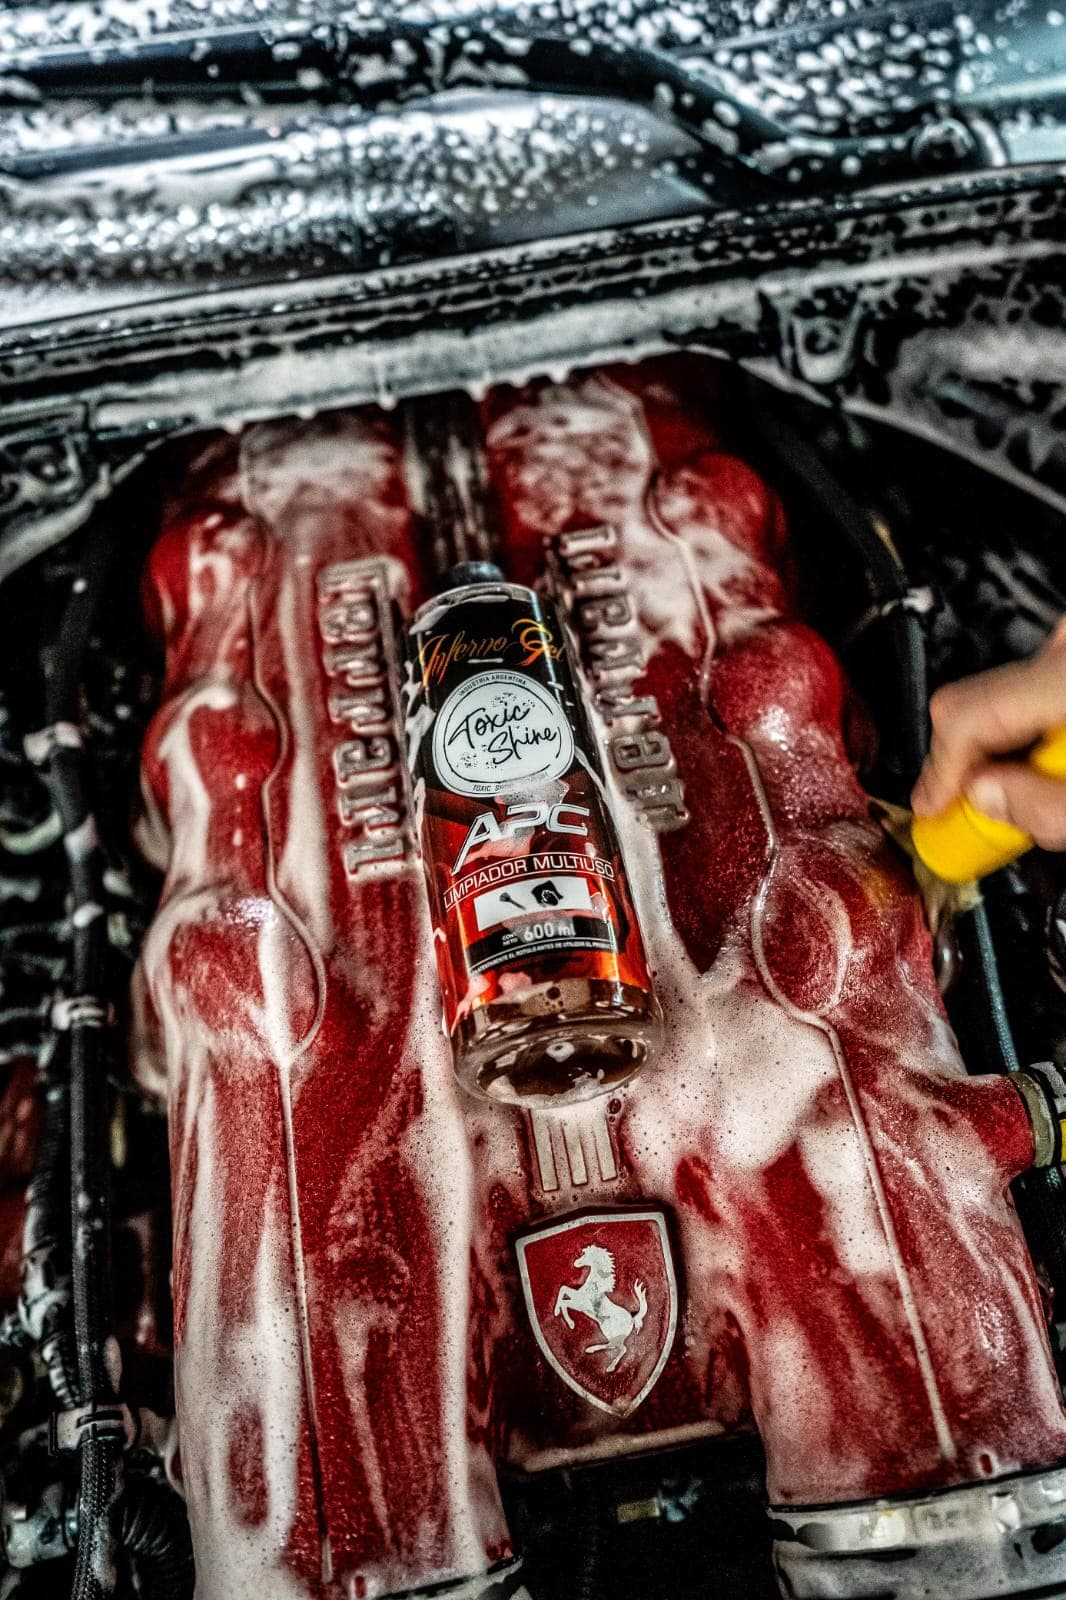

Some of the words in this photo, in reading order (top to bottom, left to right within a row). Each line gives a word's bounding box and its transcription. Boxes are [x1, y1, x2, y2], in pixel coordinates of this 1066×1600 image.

[448, 704, 531, 749] Toxic
[487, 724, 558, 764] Shine
[452, 803, 590, 876] APC
[443, 860, 529, 908] LIMPIADOR
[533, 855, 615, 877] MULTIUSO
[524, 921, 554, 942] 600
[558, 923, 576, 937] ml
